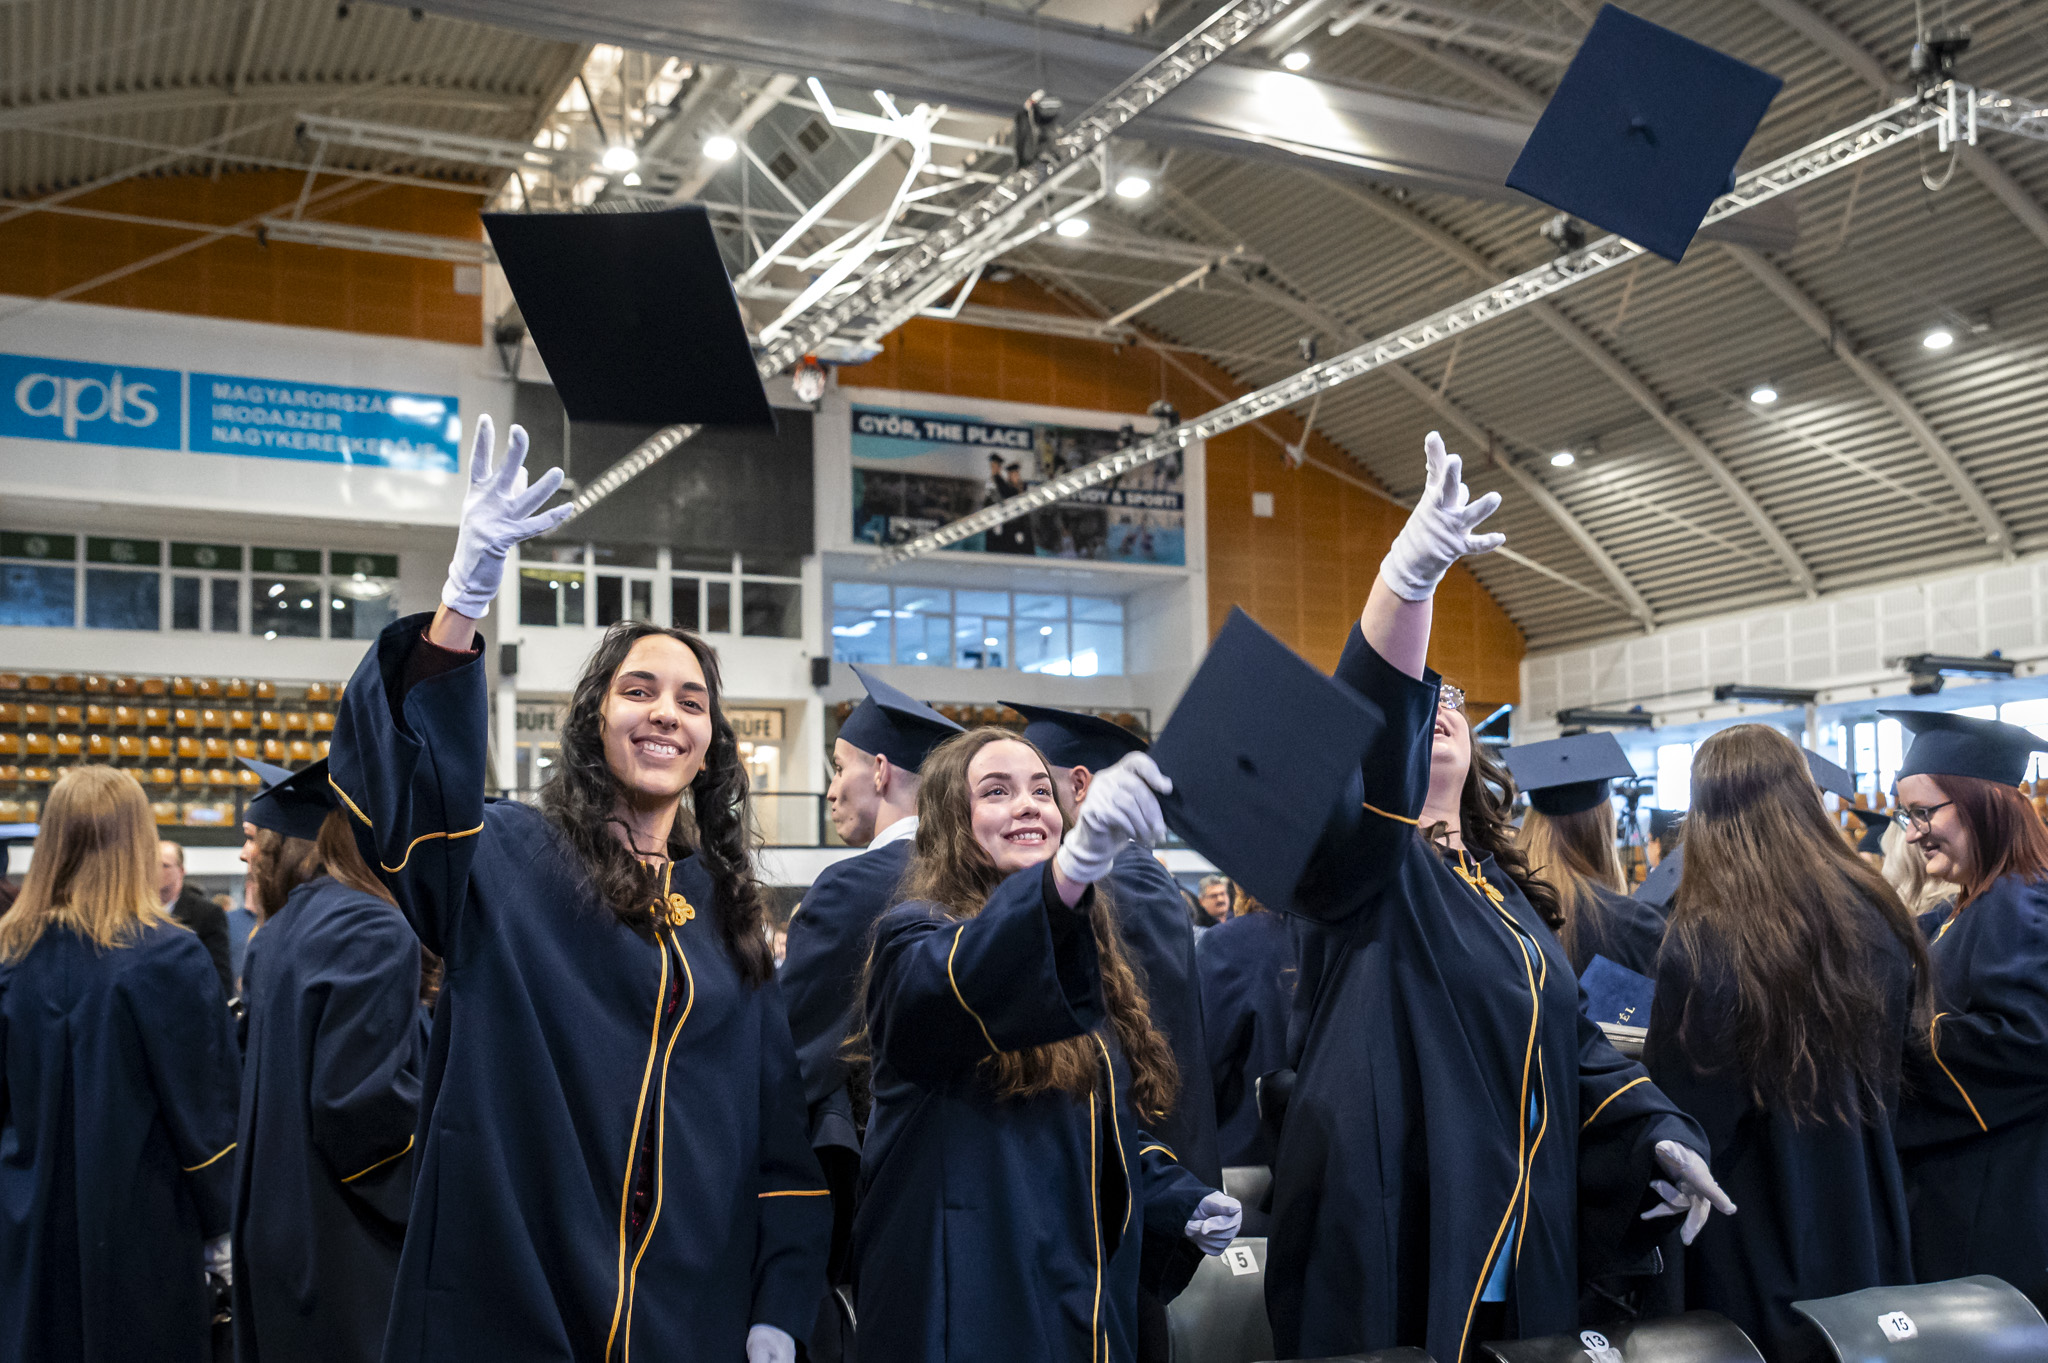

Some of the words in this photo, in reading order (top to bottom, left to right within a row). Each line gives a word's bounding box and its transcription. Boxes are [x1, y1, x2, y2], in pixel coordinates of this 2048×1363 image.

[212, 404, 342, 432] IRODASZER
[923, 421, 963, 442] THE
[966, 426, 1029, 448] PLACE
[1235, 1252, 1249, 1268] 5
[1892, 1318, 1909, 1331] 15
[1585, 1335, 1606, 1348] 13
